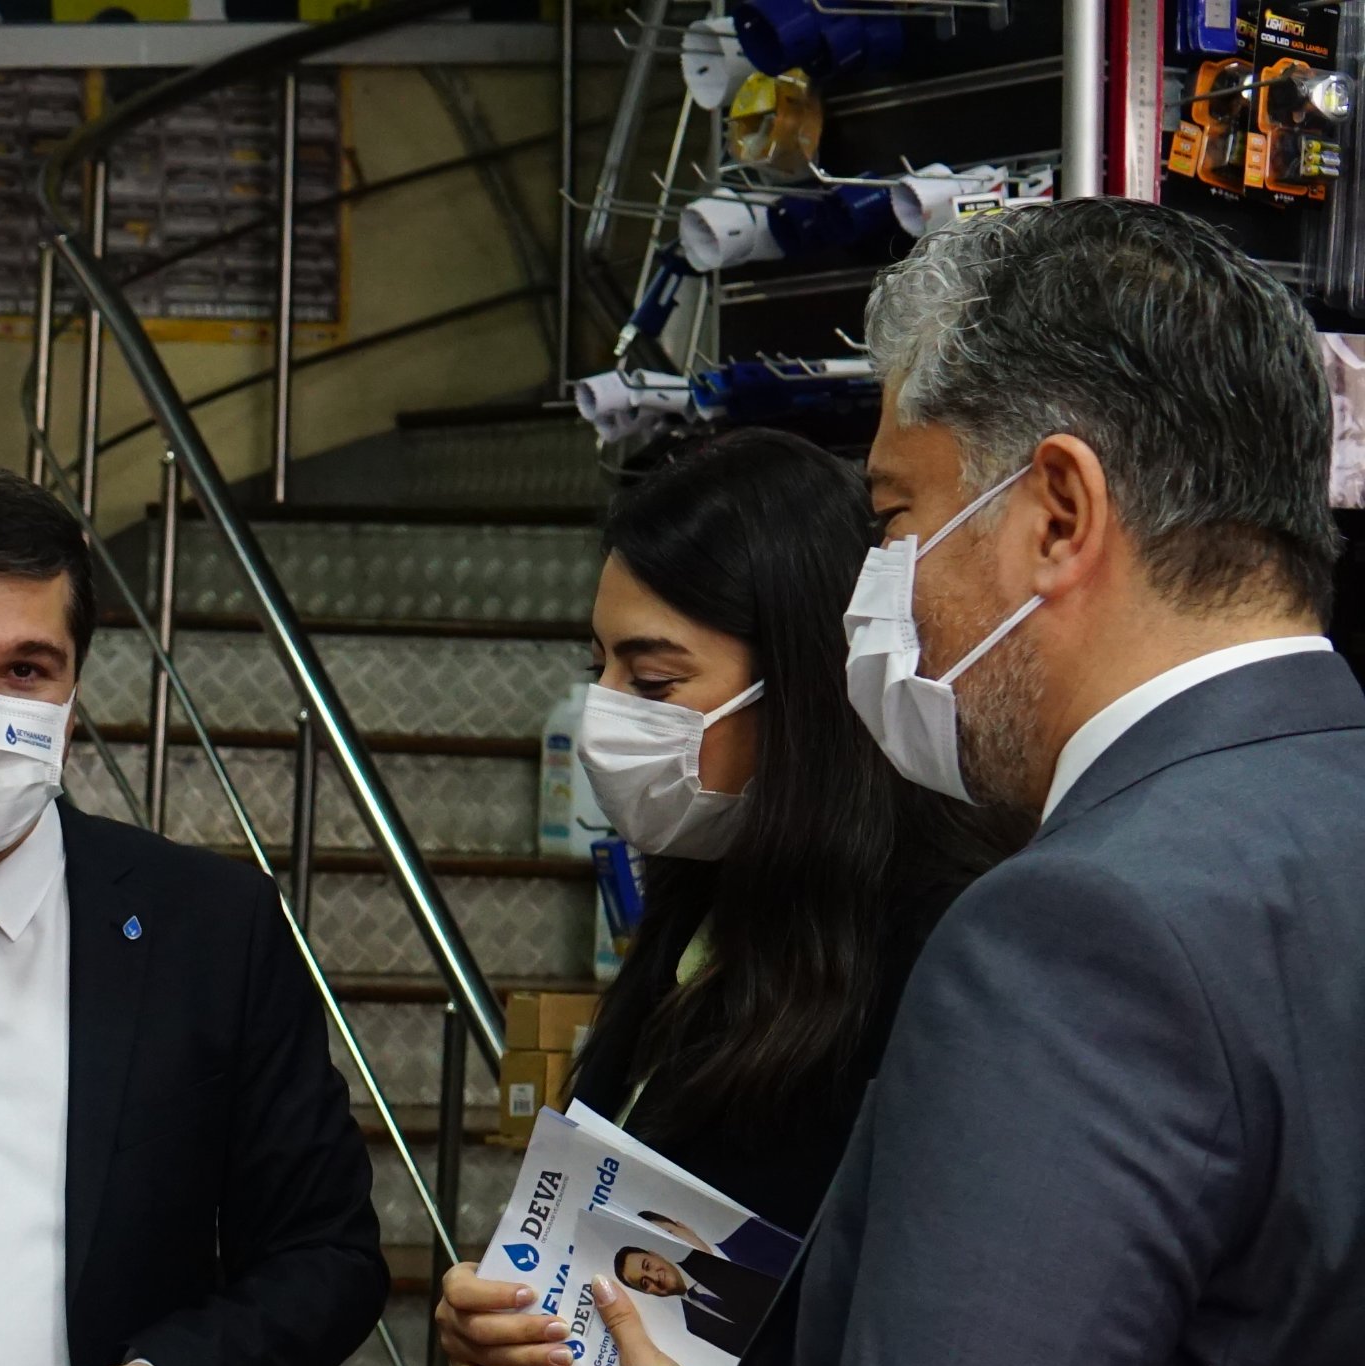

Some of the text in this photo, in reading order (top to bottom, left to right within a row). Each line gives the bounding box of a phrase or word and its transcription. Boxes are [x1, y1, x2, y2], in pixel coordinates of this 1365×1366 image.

[520, 1170, 563, 1241] DEVA
[589, 1156, 620, 1211] ında
[541, 1263, 571, 1316] EVA
[571, 1283, 595, 1337] DEVA
